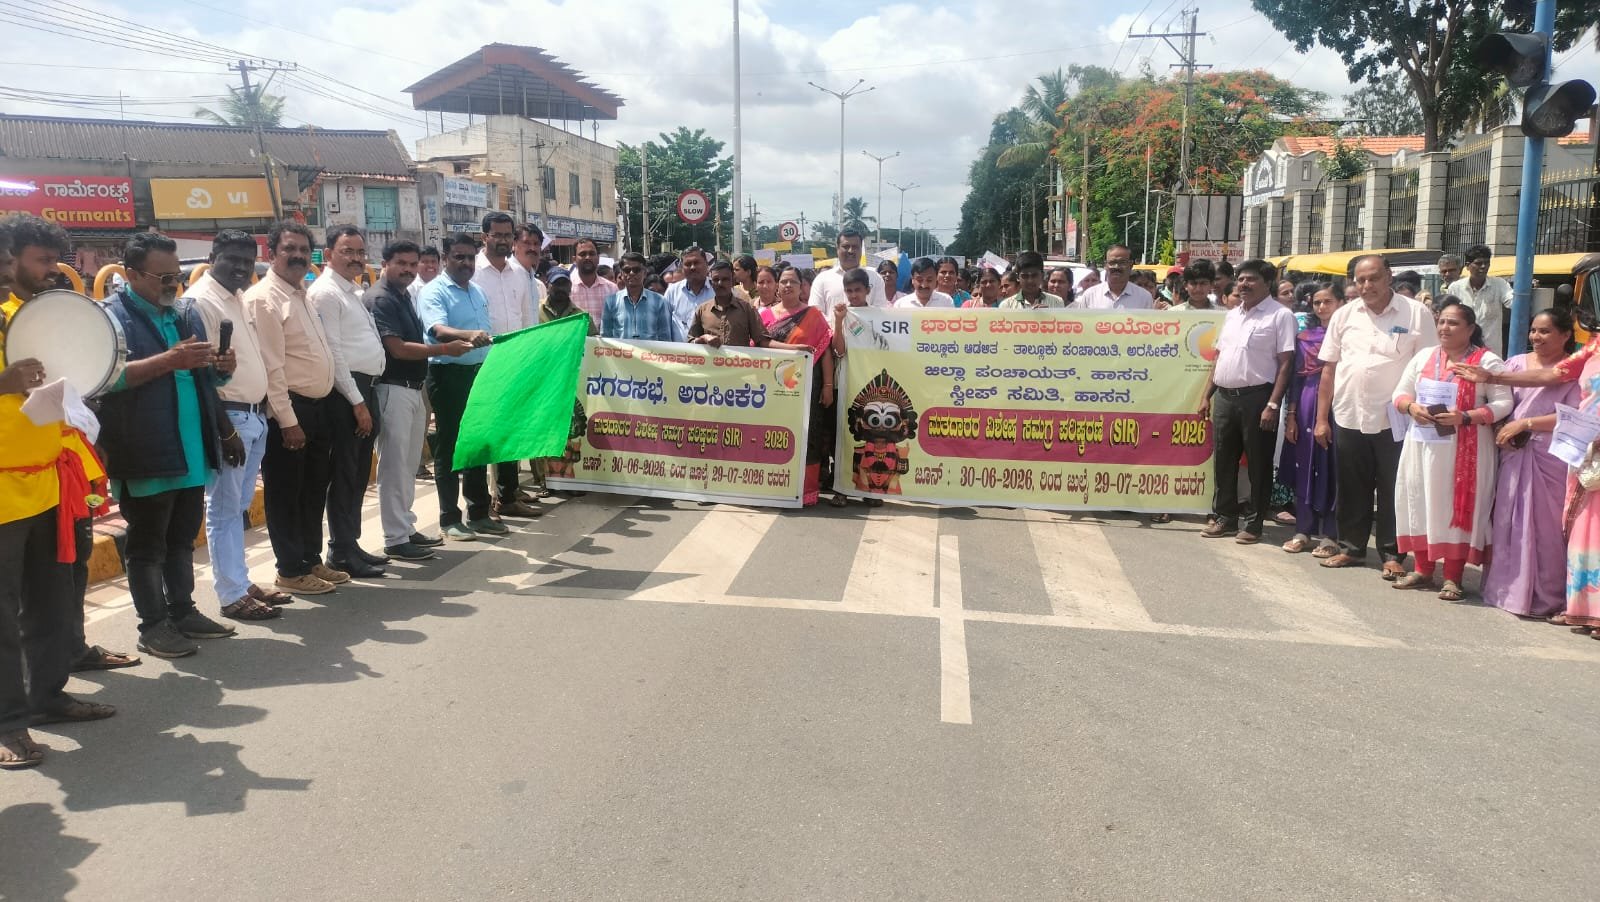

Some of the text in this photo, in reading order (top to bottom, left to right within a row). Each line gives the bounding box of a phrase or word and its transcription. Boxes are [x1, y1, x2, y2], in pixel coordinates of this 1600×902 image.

[41, 207, 132, 224] Garments
[783, 227, 795, 237] 30
[881, 320, 909, 335] SIR
[921, 316, 1181, 336] ಭಾರತ ಚುನಾವಣಾ ಆಯೋಗ
[593, 346, 772, 370] ಭಾರತ ಚುನಾವಣಾ ಆಯೋಗ
[916, 341, 959, 359] ತಾಲ್ಲೂಕು
[1014, 342, 1057, 360] ತಾಲ್ಲೂಕು
[924, 365, 966, 382] ಜಿಲ್ಲಾ
[1091, 367, 1153, 382] ಹಾಸನ.
[586, 371, 766, 409] ನಗರಸಭೆ, ಅರಸೀಕೆರೆ
[950, 385, 998, 407] ಸ್ವೀಪ್
[1074, 388, 1135, 404] ಹಾಸನ.
[722, 427, 743, 449] (SIR)
[764, 430, 789, 450] 2026
[928, 411, 981, 440] ಮತದಾರರ
[1022, 414, 1054, 451] ಸಮಗ್ರ
[1109, 418, 1140, 449] (SIR)
[1170, 420, 1206, 446] 2026
[611, 456, 666, 477] 30-06-2026,
[711, 466, 764, 486] 29-07-2026
[914, 462, 944, 486] ಜೂನ್
[960, 466, 1035, 491] 30-06-2026,
[1039, 468, 1063, 492] ರಿಂದ
[1094, 472, 1169, 496] 29-07-2026
